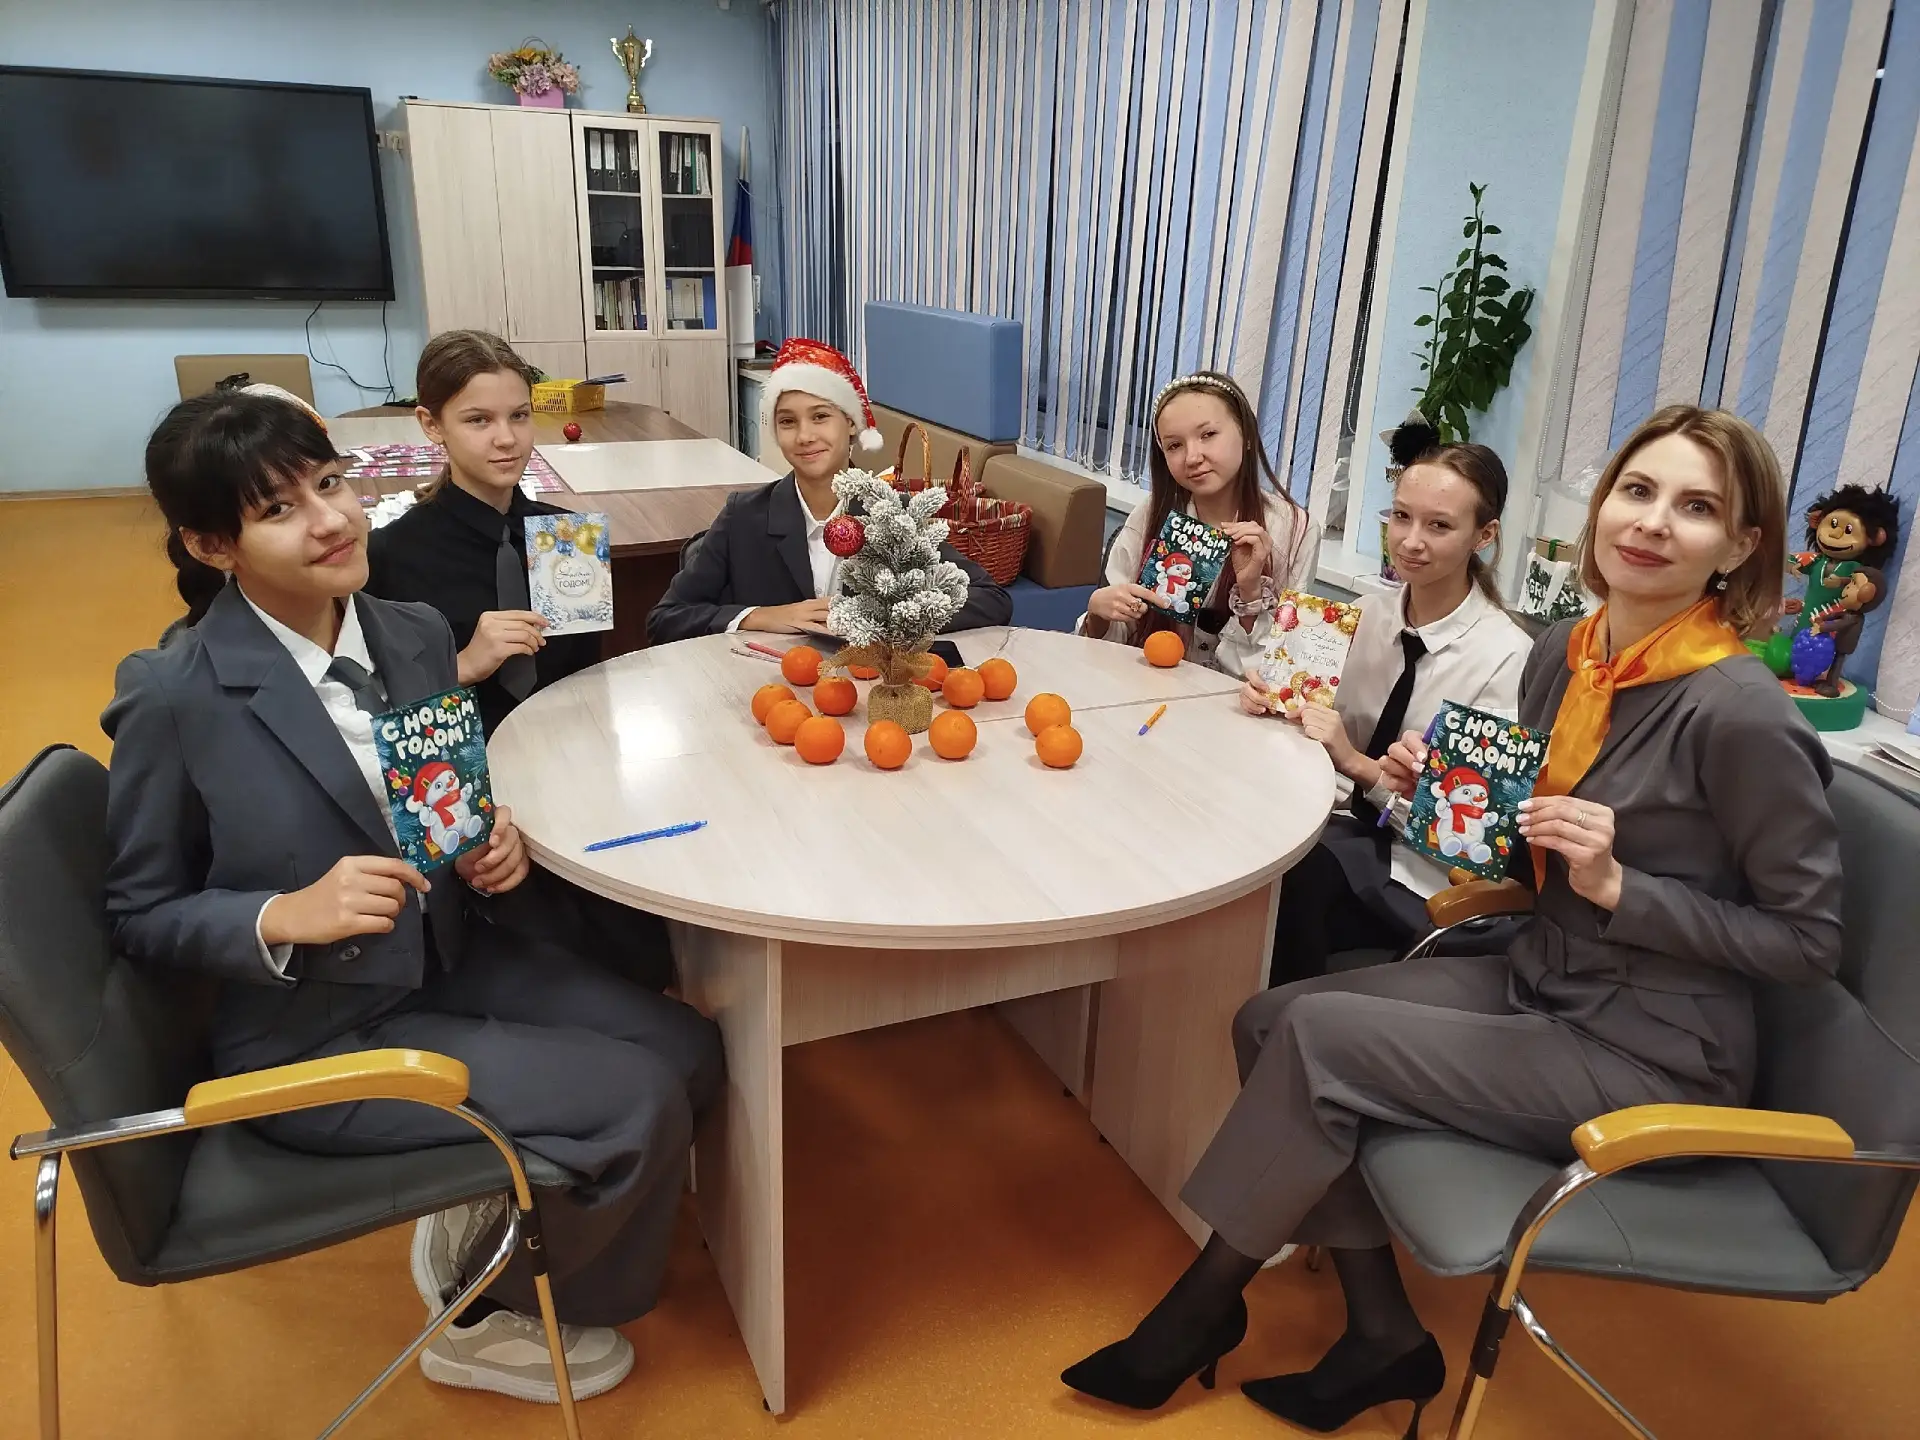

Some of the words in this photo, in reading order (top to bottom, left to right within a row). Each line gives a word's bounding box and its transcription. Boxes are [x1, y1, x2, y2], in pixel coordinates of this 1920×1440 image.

[1171, 516, 1182, 529] С
[1182, 522, 1228, 550] НОВЫМ
[1171, 530, 1219, 560] ГОДОМ!
[381, 721, 400, 742] С
[403, 699, 475, 736] НОВЫМ
[395, 720, 471, 760] ГОДОМ!
[1445, 711, 1461, 729] С
[1464, 716, 1540, 758] НОВЫМ
[1448, 733, 1527, 776] ГОДОМ!
